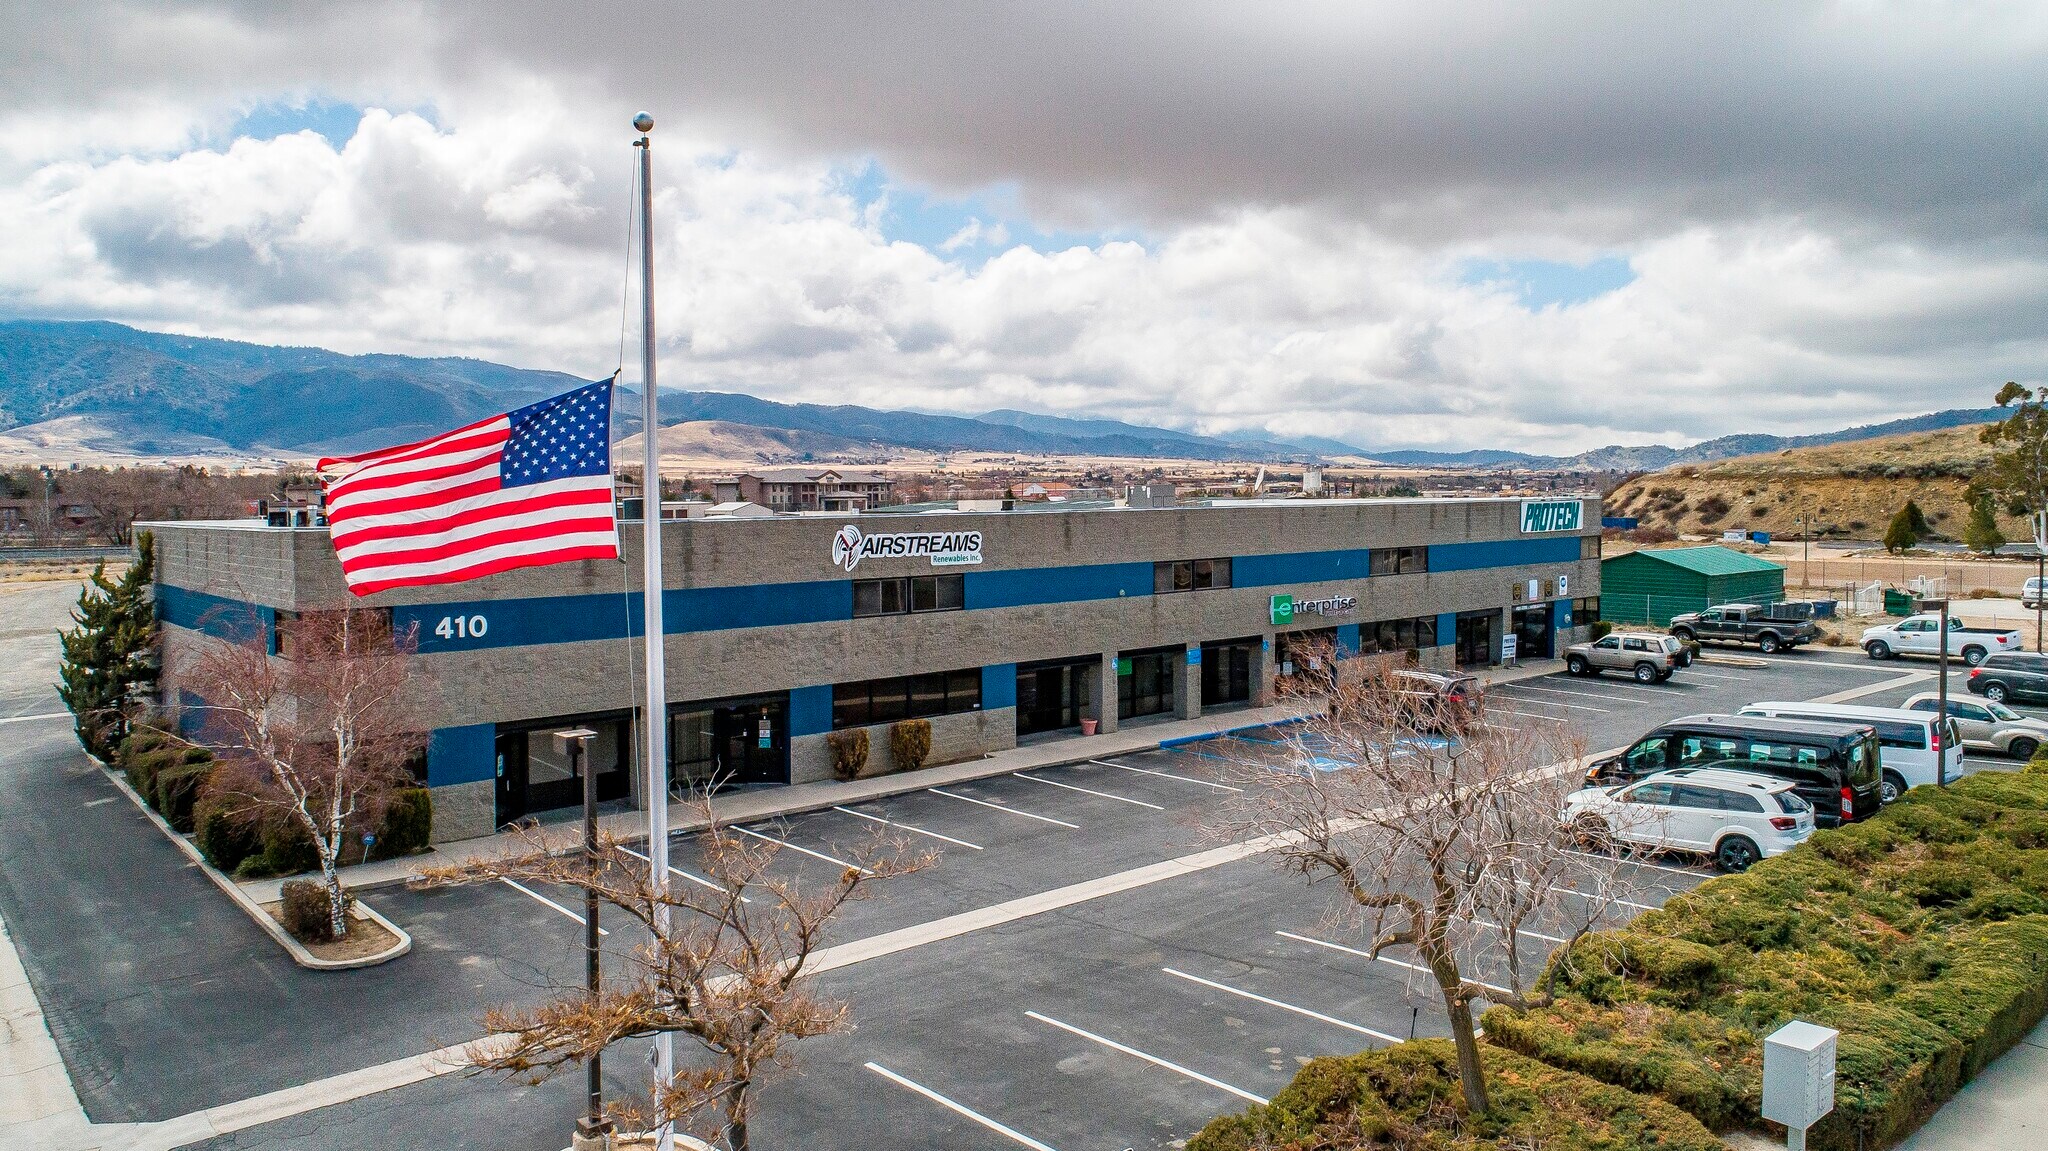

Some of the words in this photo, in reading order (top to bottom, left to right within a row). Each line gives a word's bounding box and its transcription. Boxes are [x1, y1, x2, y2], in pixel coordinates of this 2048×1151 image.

[1523, 502, 1580, 531] PROTECH
[861, 534, 980, 555] AIRSTREAMS
[933, 554, 969, 563] Renewables
[1274, 596, 1357, 616] enterprise
[435, 615, 488, 639] 410
